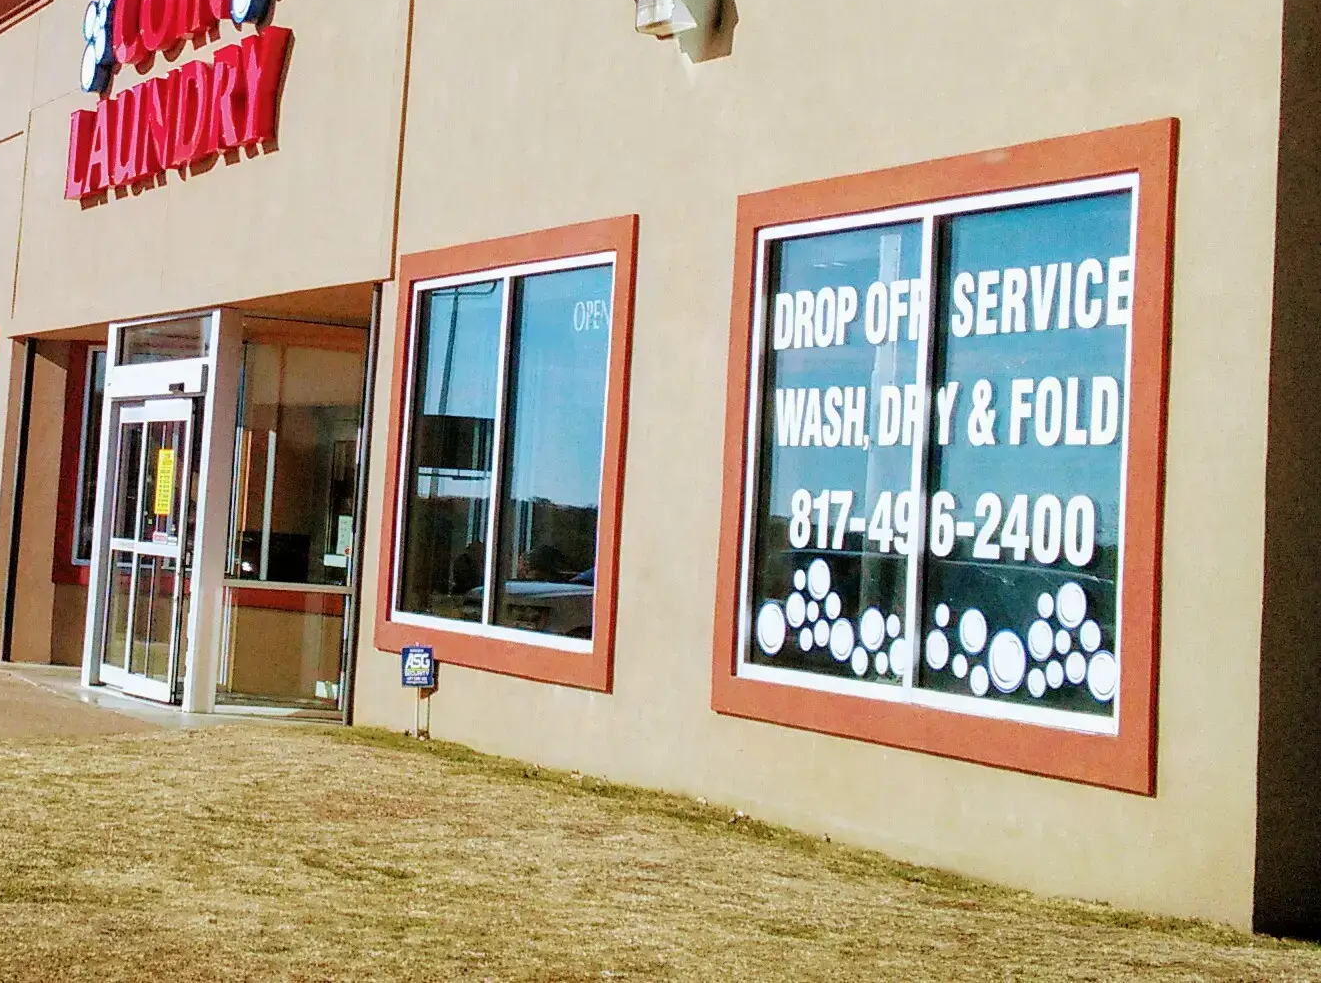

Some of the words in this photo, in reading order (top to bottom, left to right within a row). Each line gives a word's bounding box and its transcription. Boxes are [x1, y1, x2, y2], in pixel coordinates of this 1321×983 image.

[64, 27, 294, 199] LAUNDRY
[573, 299, 610, 332] OPEN
[774, 285, 858, 351] DROP
[951, 255, 1134, 339] SERVICE
[775, 386, 870, 451] WASH,
[967, 379, 996, 447] &
[1009, 375, 1119, 446] FOLD
[789, 488, 1095, 568] 817-496-2400
